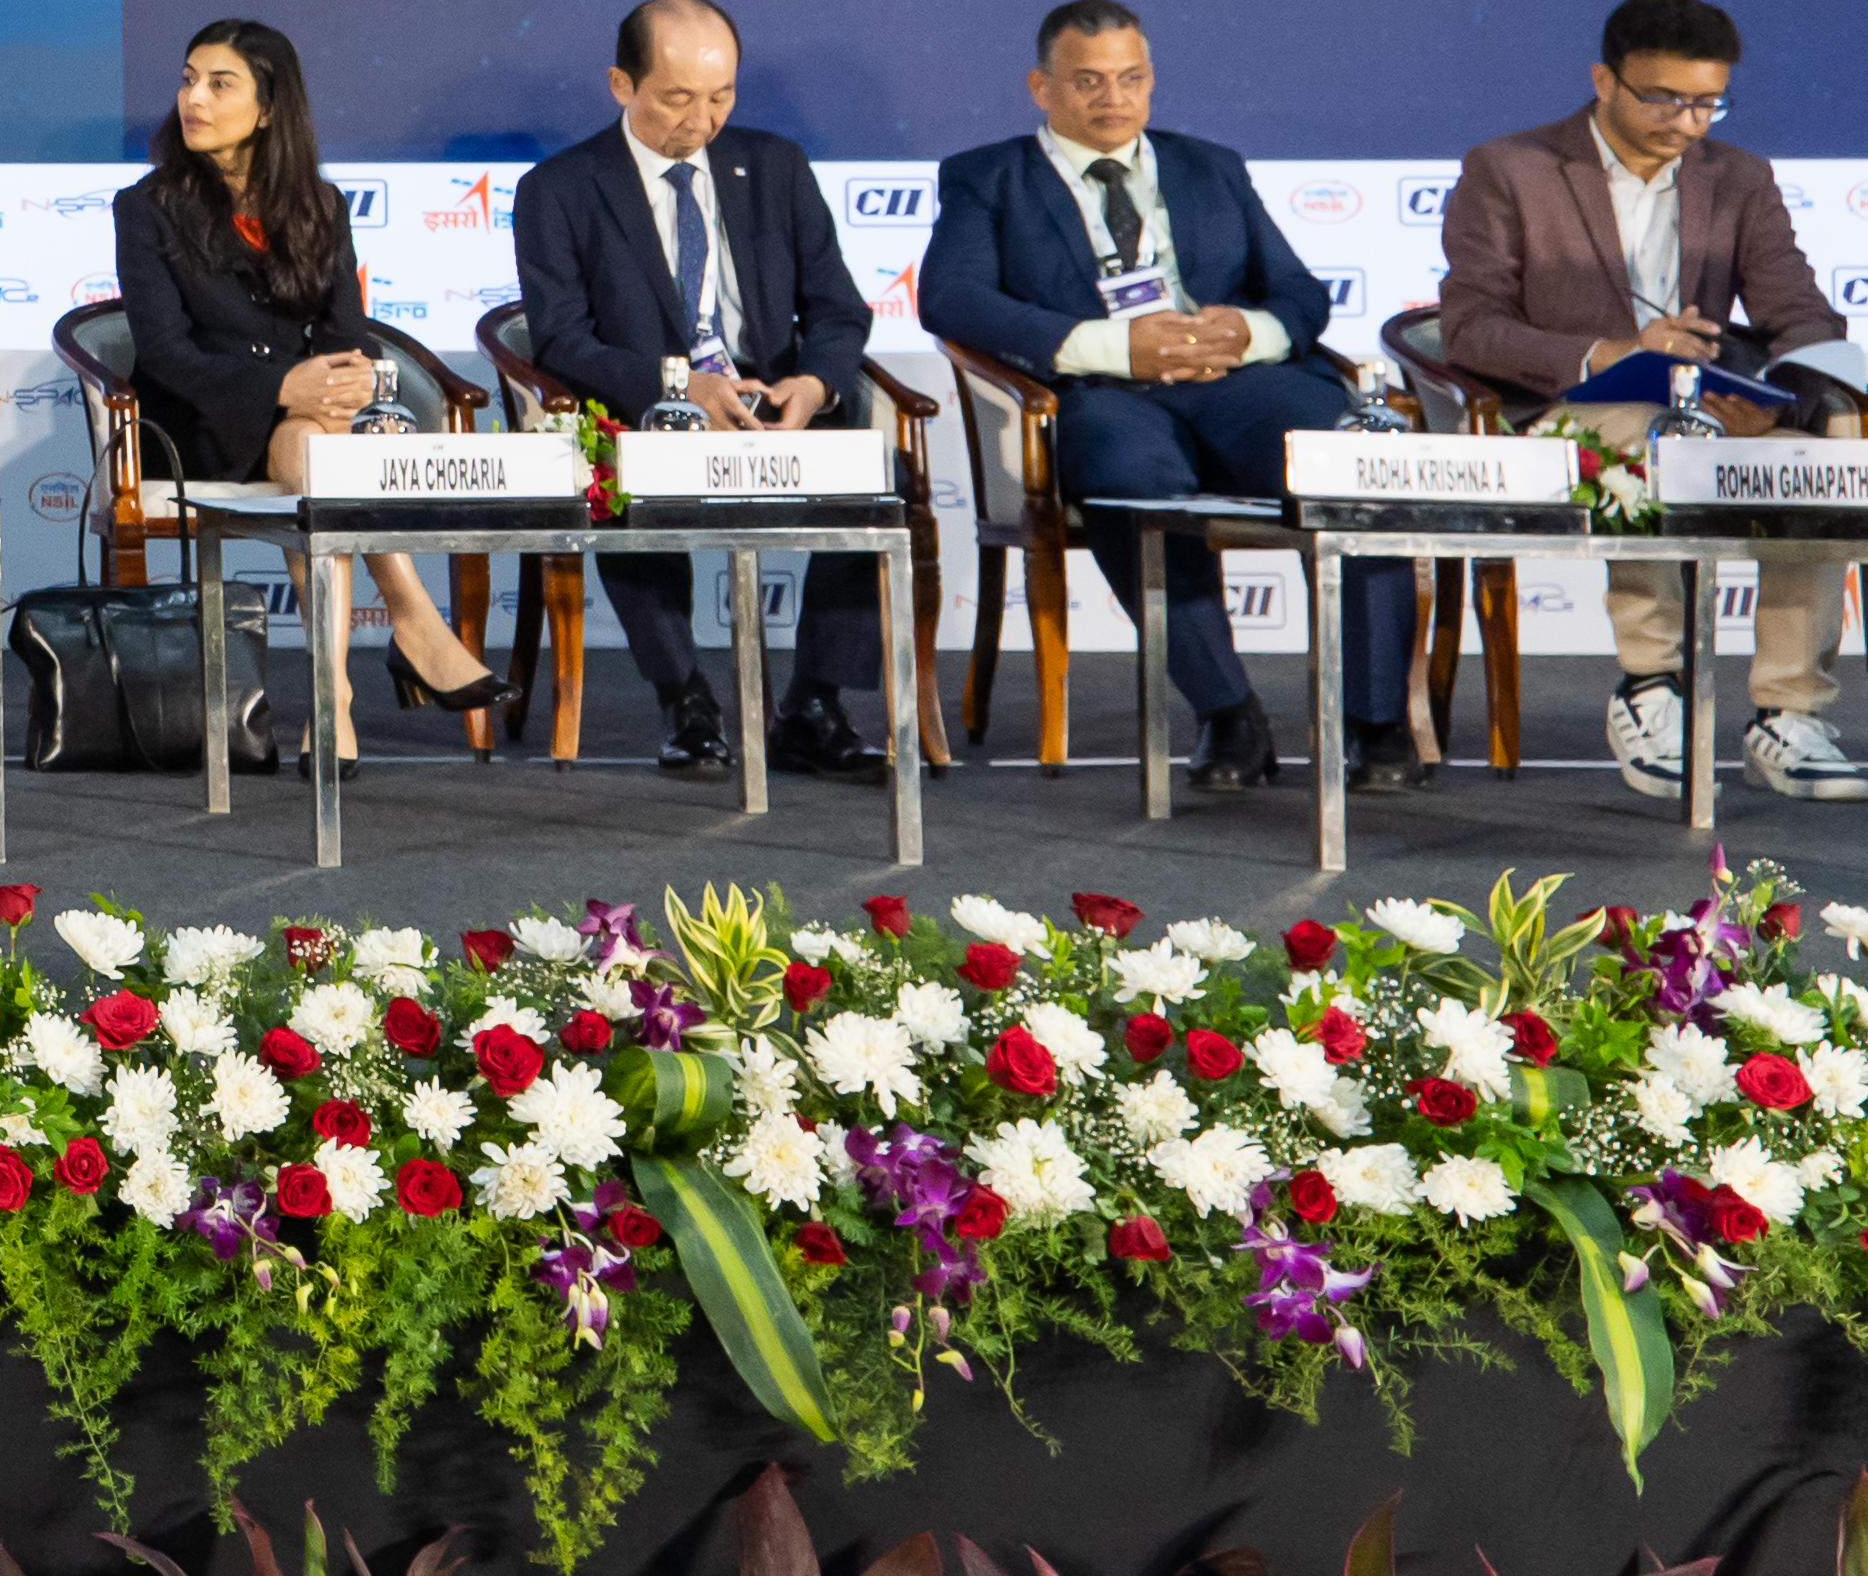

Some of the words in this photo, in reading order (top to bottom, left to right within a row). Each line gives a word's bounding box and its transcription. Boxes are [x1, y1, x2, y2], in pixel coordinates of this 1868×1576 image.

[856, 189, 923, 216] CII
[379, 458, 420, 491] JAYA
[425, 458, 506, 491] CHORARIA
[706, 455, 743, 489] ISHII
[748, 455, 800, 488] YASUO
[1356, 457, 1412, 492] RADHA
[1417, 459, 1490, 492] KRISHNA
[1496, 461, 1506, 491] A
[1716, 464, 1774, 500] ROHAN
